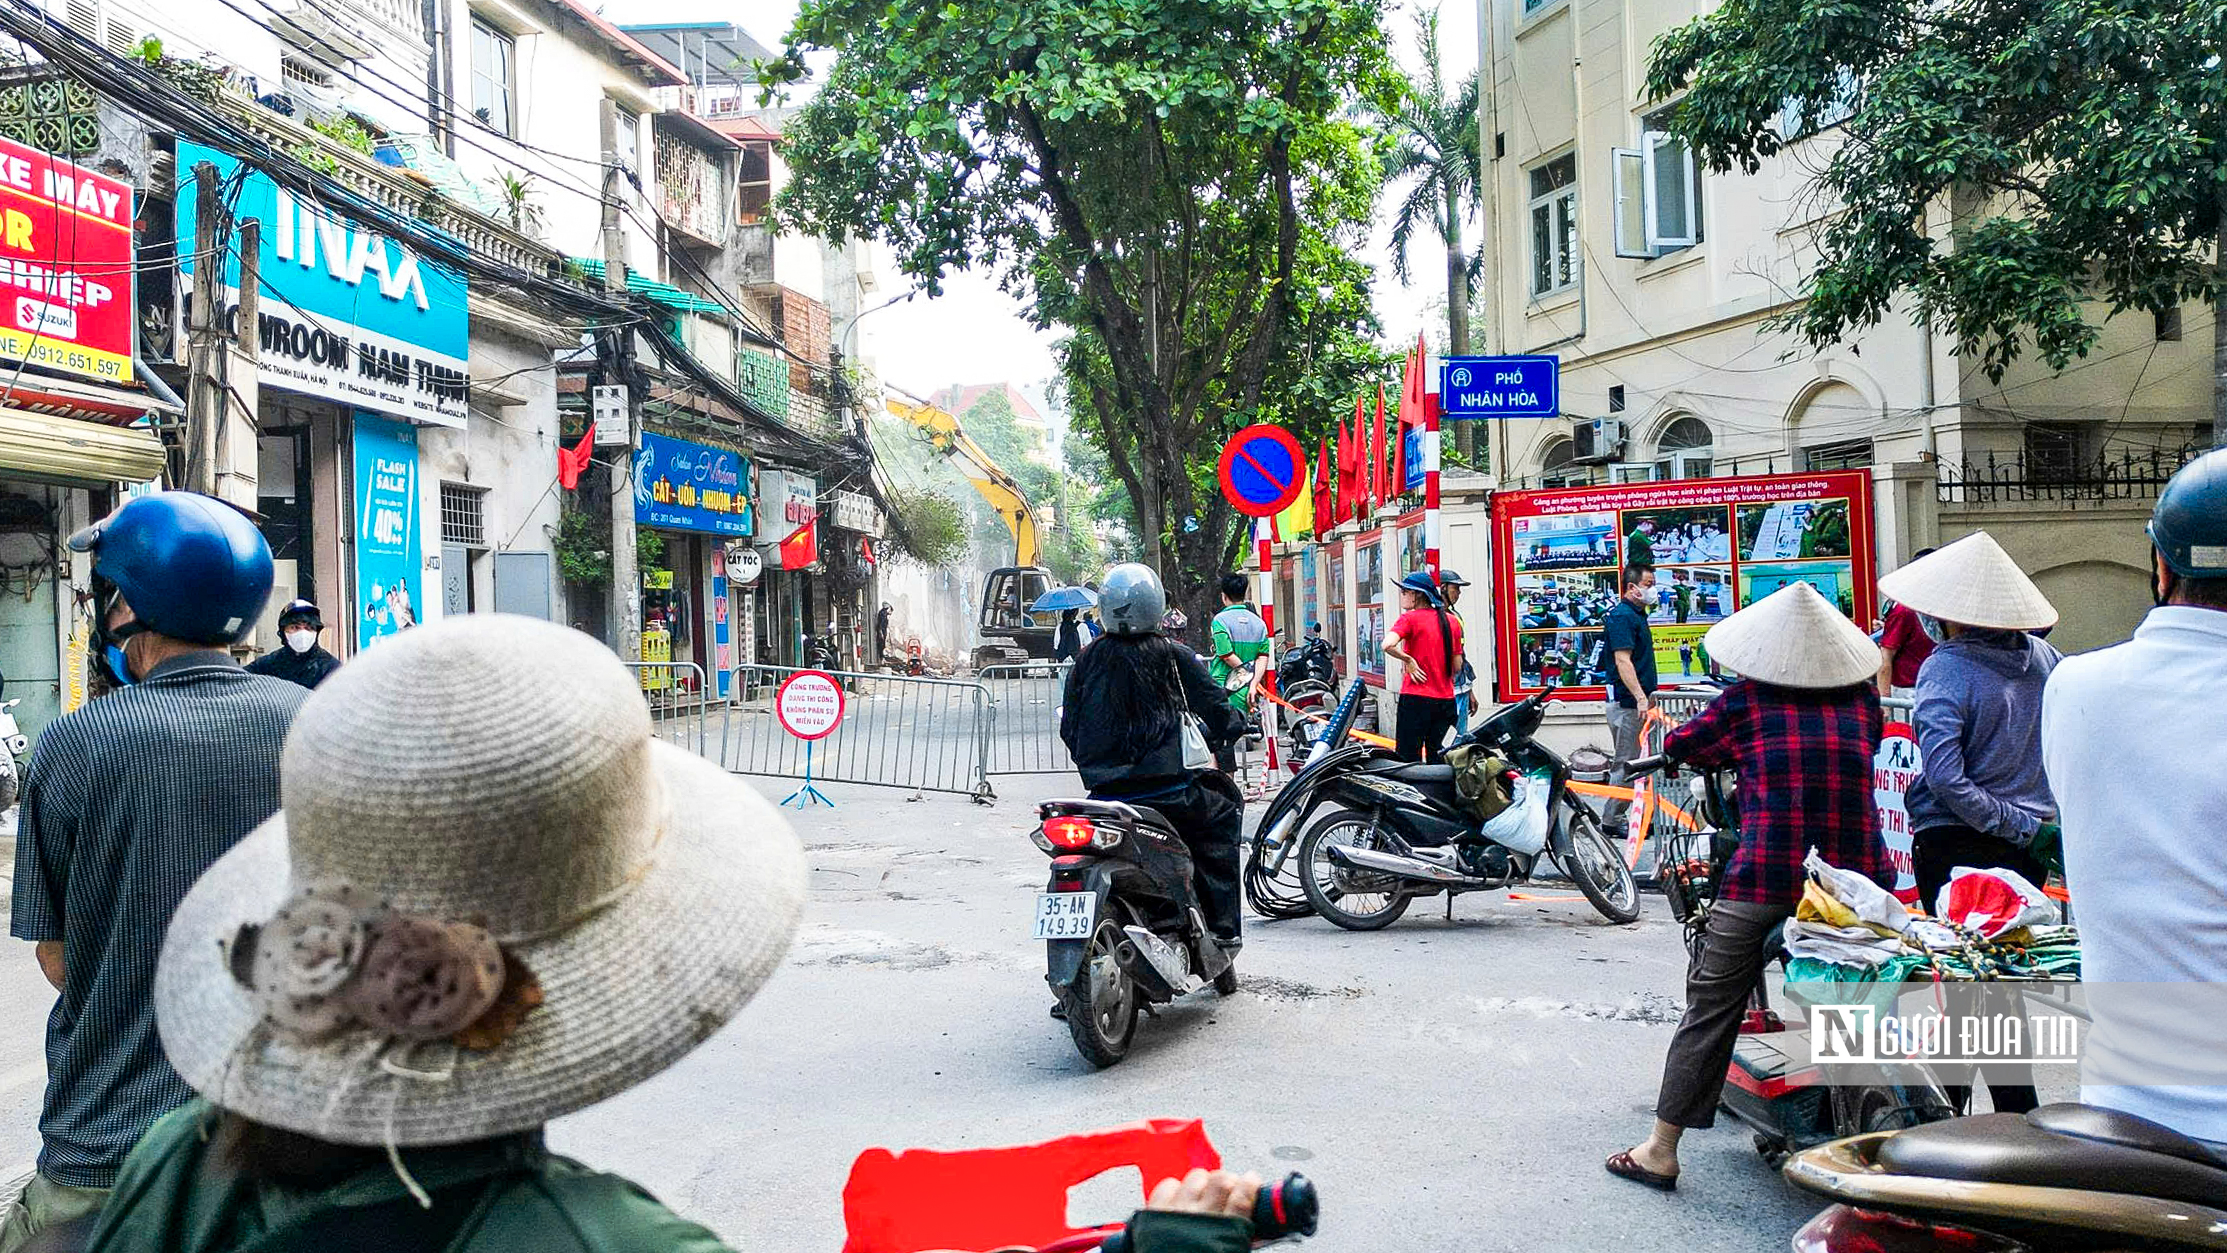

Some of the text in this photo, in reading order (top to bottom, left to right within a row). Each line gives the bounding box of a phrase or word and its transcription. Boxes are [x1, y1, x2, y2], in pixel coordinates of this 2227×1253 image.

[44, 169, 121, 219] MÁY
[276, 188, 430, 311] INAX
[37, 311, 72, 328] SUZUKI
[29, 344, 120, 376] 0912.651.597
[358, 342, 410, 388] NAM
[1495, 367, 1523, 384] PHỐ
[1460, 388, 1539, 407] NHÂN HÒA
[377, 458, 406, 475] FLASH
[376, 473, 405, 493] SALE
[653, 473, 670, 504] CẮT
[702, 488, 731, 515] NHUỘM
[1533, 498, 1551, 506] Công
[1560, 496, 1586, 505] phường
[1587, 494, 1605, 503] tuyên
[1605, 492, 1626, 502] truyền
[1667, 490, 1680, 498] học
[1681, 488, 1695, 496] sinh
[1704, 487, 1722, 495] phạm
[1723, 485, 1739, 494] Luật
[1740, 484, 1753, 492] Trật
[1775, 482, 1790, 490] toàn
[1791, 482, 1806, 490] giao
[1580, 503, 1600, 511] chống
[1632, 499, 1645, 508] Gây
[1656, 497, 1668, 505] trật
[1695, 496, 1712, 504] cộng
[1713, 494, 1722, 502] tại
[1723, 494, 1740, 502] 100%
[1742, 493, 1765, 502] trường
[1767, 492, 1780, 500] học
[1796, 490, 1807, 498] địa
[818, 695, 834, 703] CÔNG
[1888, 808, 1904, 833] THI
[1045, 896, 1086, 915] 35-AN
[1039, 917, 1089, 936] 149.39
